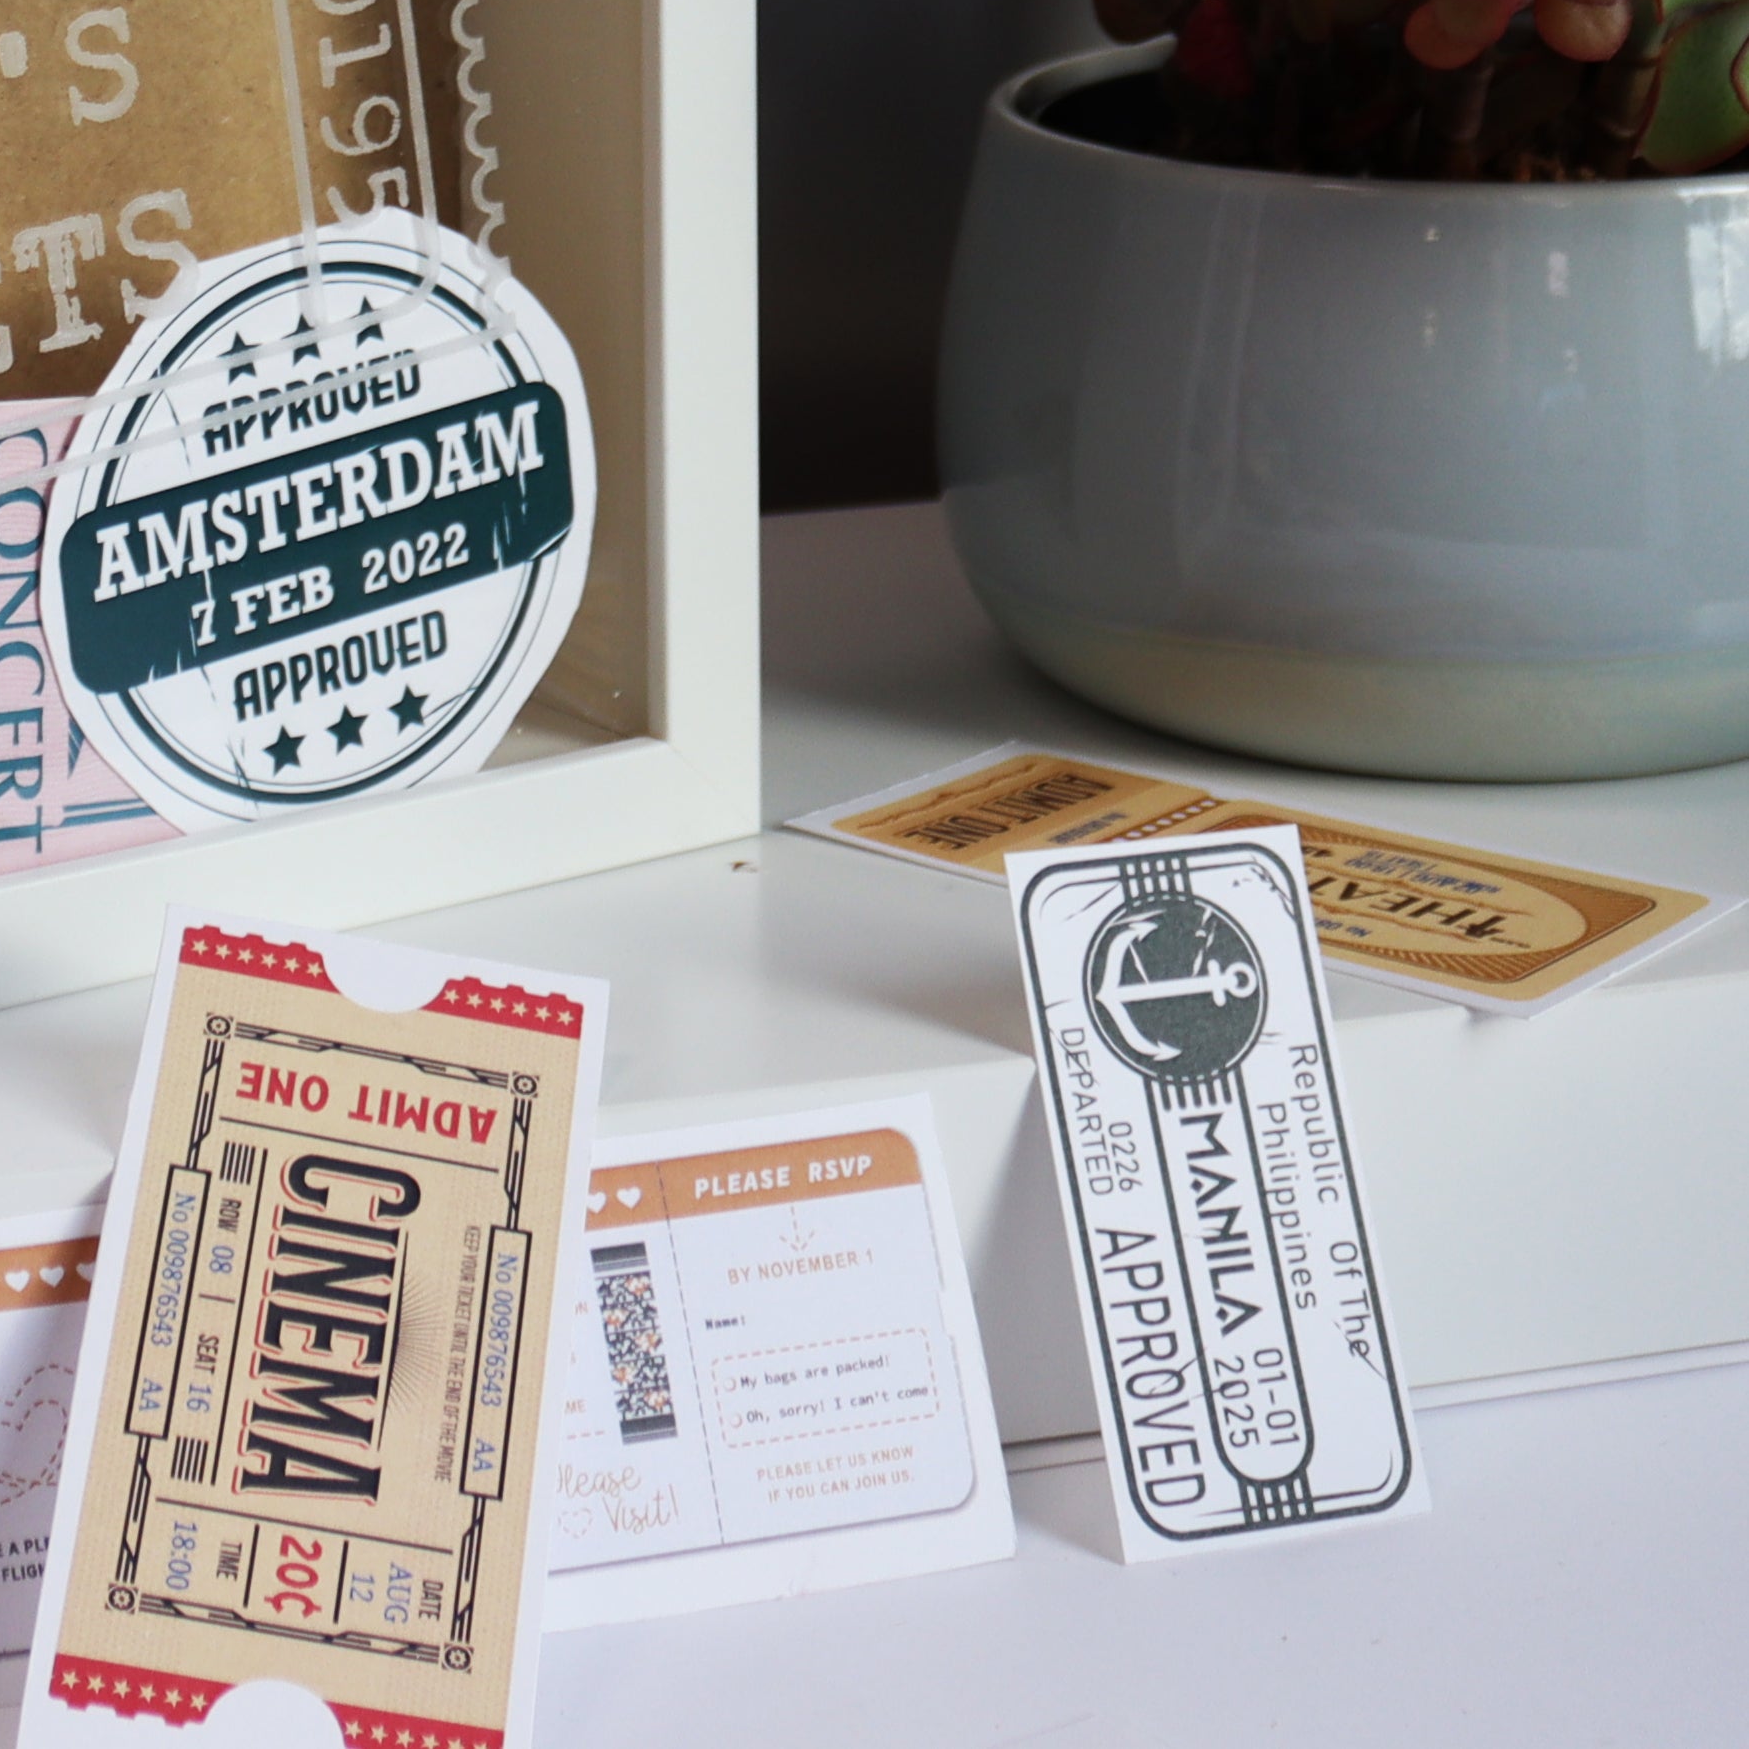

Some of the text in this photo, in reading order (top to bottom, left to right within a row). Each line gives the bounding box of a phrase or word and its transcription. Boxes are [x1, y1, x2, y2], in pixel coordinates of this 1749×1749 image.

[202, 348, 421, 457] APPROVED
[93, 401, 544, 602] AMSTERDAM
[191, 523, 470, 647] 7 FEB 2022
[233, 609, 448, 722] APPROVED
[235, 1061, 498, 1144] ADMIT ONE
[1061, 1027, 1114, 1195] DEPARTED
[695, 1155, 872, 1200] PLEASE RSVP
[1108, 1122, 1142, 1192] 0226
[1289, 1044, 1373, 1357] Republic Of The
[1179, 1112, 1263, 1336] MANILA
[1257, 1102, 1316, 1309] Philippines
[138, 1193, 196, 1412] No 009876543 AA
[186, 1197, 241, 1413] ROW 08 SEAT 16
[727, 1266, 751, 1285] BY
[758, 1251, 858, 1280] NOVEMBER
[232, 1154, 421, 1506] CINEMA
[434, 1225, 481, 1483] KEEP YOUR TICKET UNTIL THE END OF THE MOVIE
[472, 1253, 518, 1473] No 009876543 AA
[740, 1354, 890, 1390] My bags are packed!
[1094, 1227, 1206, 1508] APPROVED
[747, 1386, 928, 1424] Oh, sorry! I can't come
[1214, 1356, 1260, 1448] 2025
[1253, 1348, 1300, 1446] 01-01
[757, 1446, 914, 1482] PLEASE LET US KNOW
[768, 1489, 780, 1503] IF
[786, 1484, 815, 1500] YOU
[820, 1479, 850, 1495] CAN
[854, 1474, 886, 1490] JOIN
[8, 1540, 20, 1557] A
[166, 1521, 197, 1591] 18:00
[216, 1540, 242, 1582] TIME
[349, 1572, 375, 1603] 12
[384, 1562, 413, 1624] AUG
[418, 1578, 443, 1621] DATE
